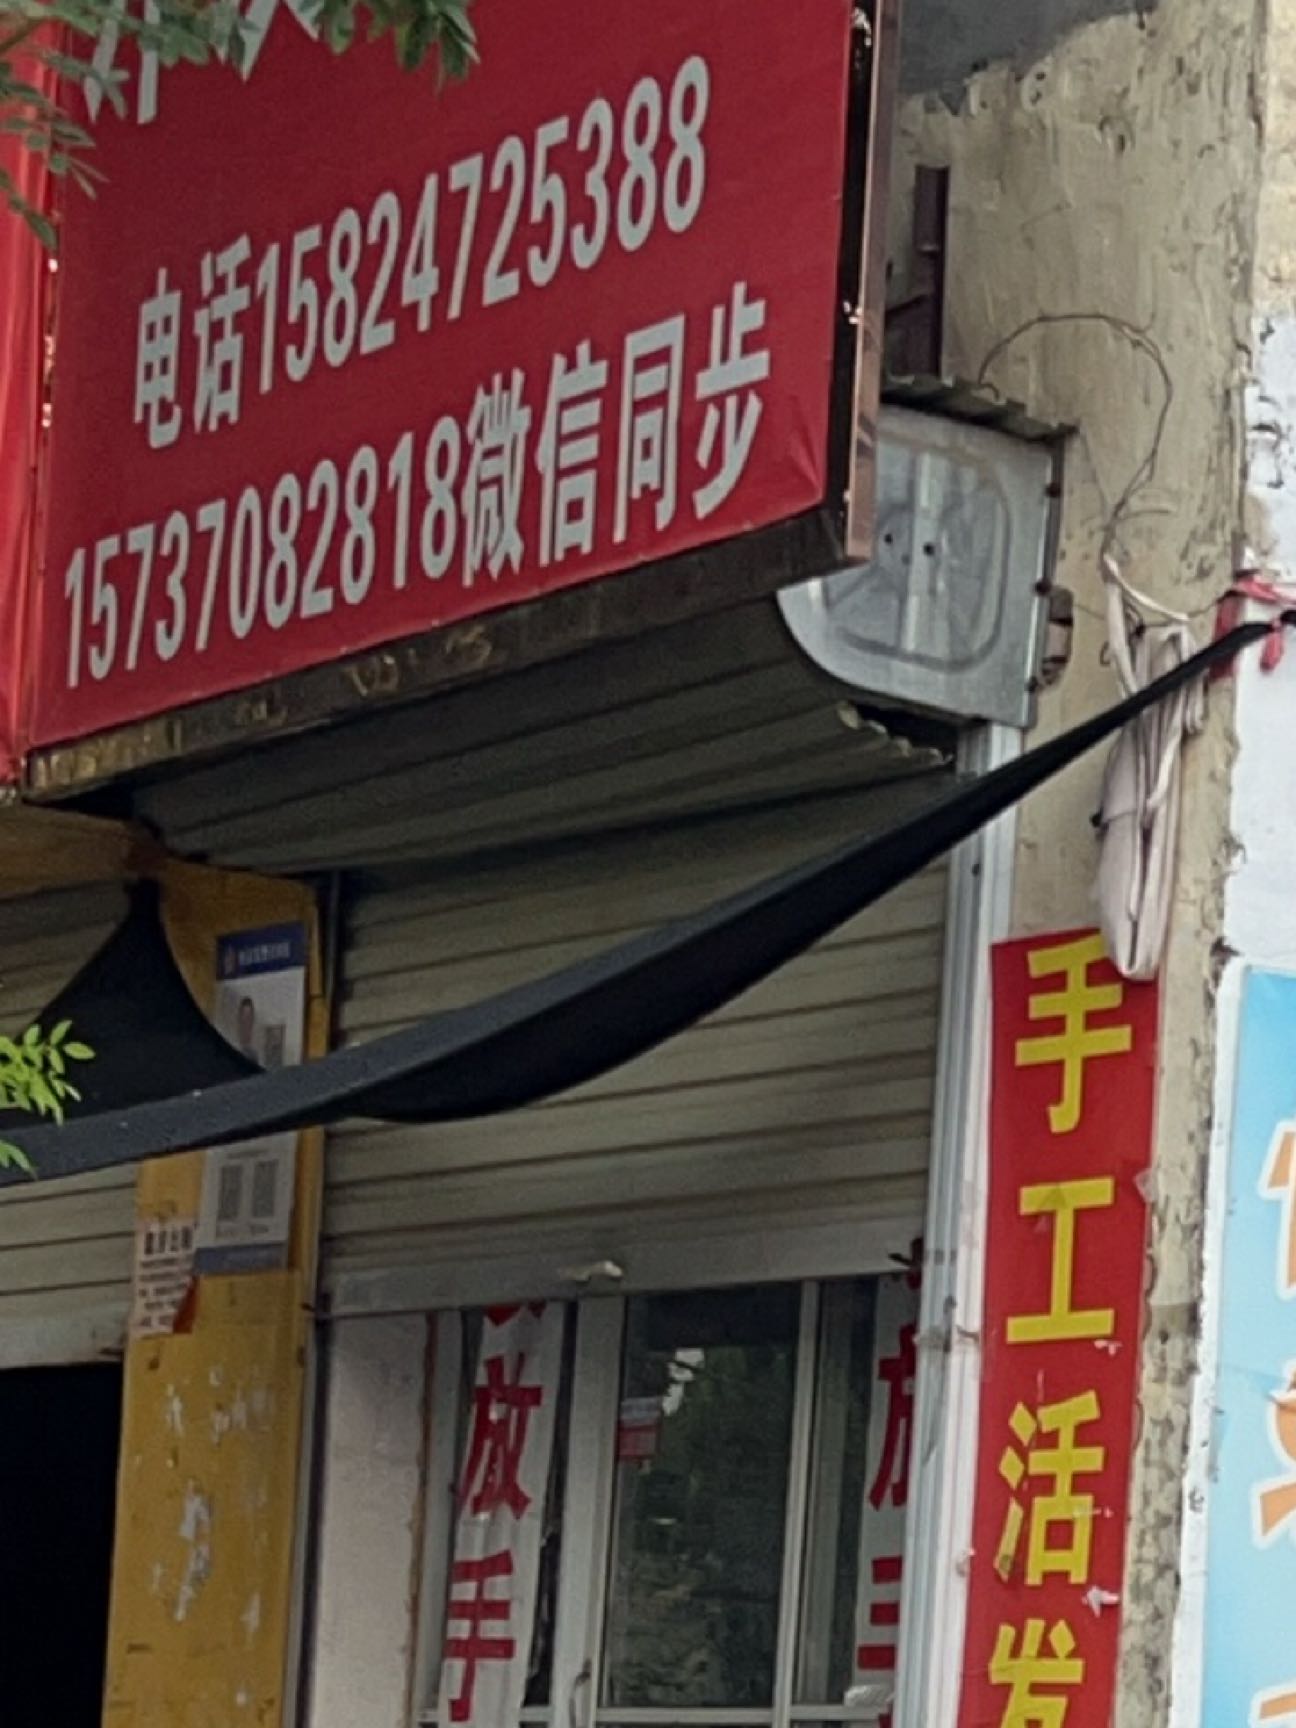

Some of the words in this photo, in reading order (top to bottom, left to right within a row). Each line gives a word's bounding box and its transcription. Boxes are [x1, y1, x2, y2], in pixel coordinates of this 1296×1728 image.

[133, 56, 710, 448] 电话15824725388
[65, 281, 771, 688] 15737082818微信同步
